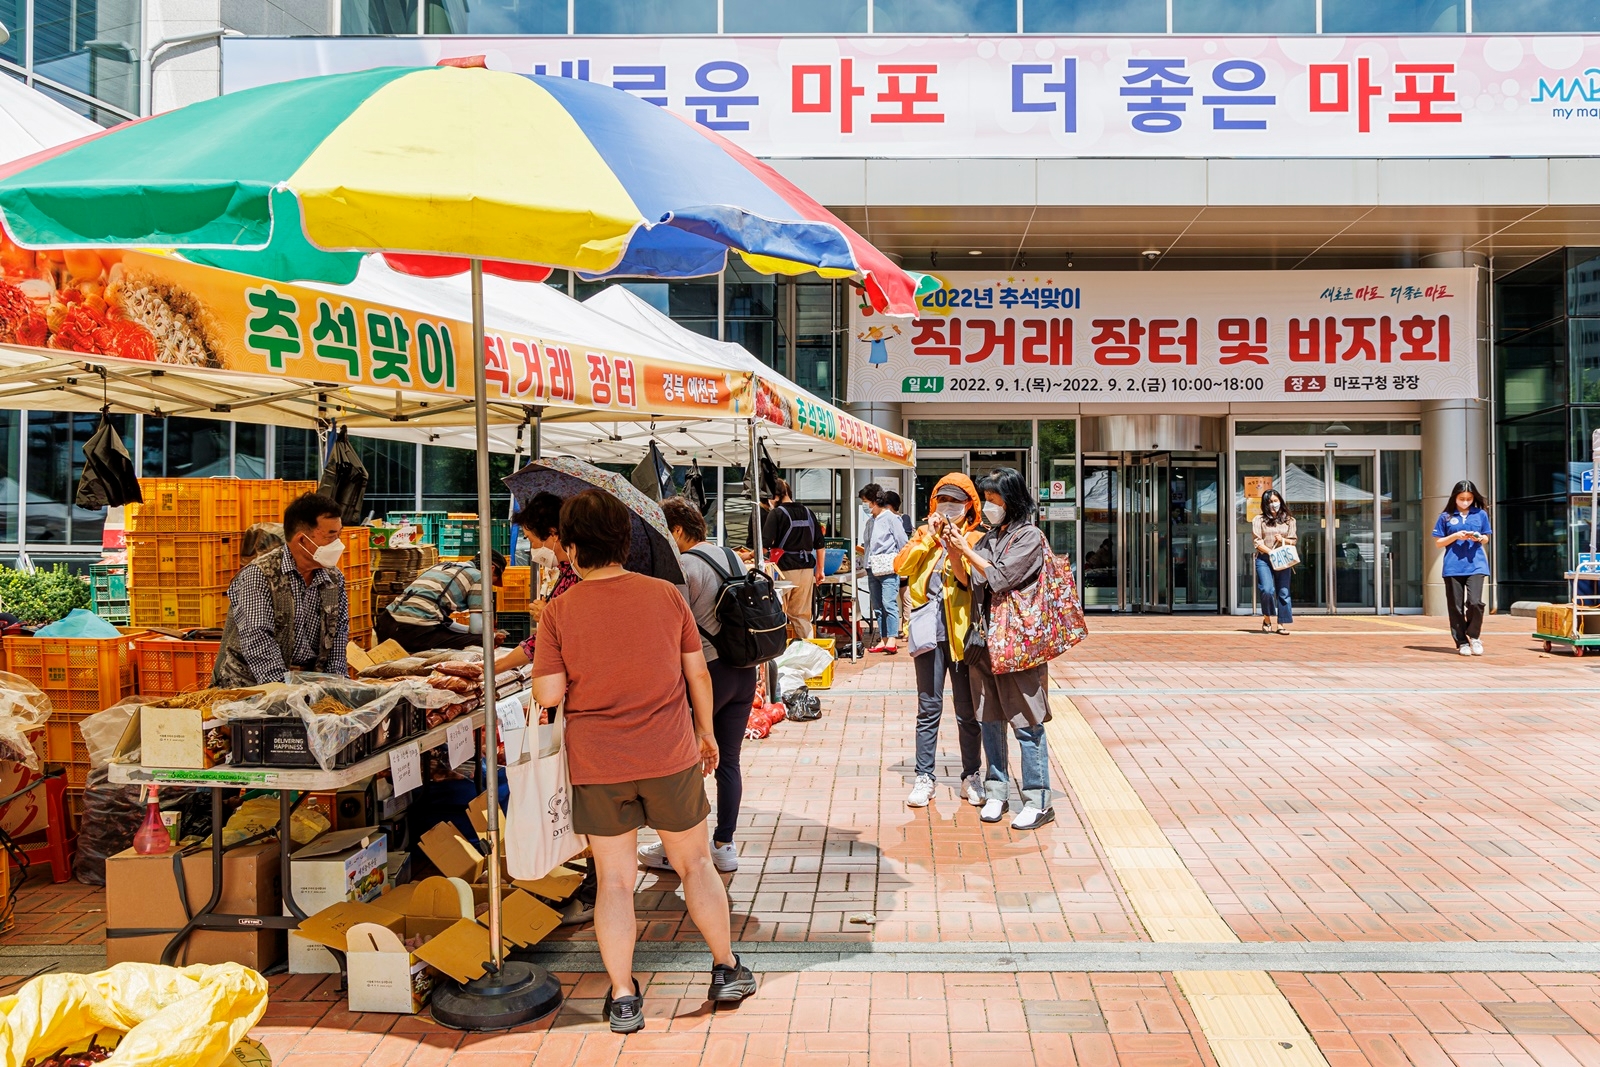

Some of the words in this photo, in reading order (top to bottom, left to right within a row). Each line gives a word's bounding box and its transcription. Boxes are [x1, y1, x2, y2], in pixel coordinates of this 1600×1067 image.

[534, 59, 759, 131] 로운
[791, 58, 945, 134] 마포
[1011, 57, 1077, 133] 더
[1119, 58, 1276, 133] 좋은
[1308, 57, 1462, 133] 마포
[1553, 108, 1573, 120] my
[1577, 108, 1600, 119] ma
[921, 287, 993, 309] 2022년
[999, 287, 1081, 309] 추석맞이
[1320, 286, 1354, 303] 새로운
[1355, 285, 1385, 301] 마포
[1390, 285, 1402, 304] 더
[1425, 284, 1454, 302] 마포
[248, 289, 455, 388] 추석맞이
[484, 336, 576, 401] 직거래
[587, 354, 637, 407] 장터
[910, 317, 1073, 365] 직거래
[1091, 317, 1198, 365] 장터
[1218, 316, 1270, 365] 및
[1288, 314, 1451, 364] 바자회
[662, 373, 685, 402] 경북
[687, 376, 719, 405] 예천군
[950, 378, 990, 391] 2022.
[995, 378, 1009, 391] 9.
[1107, 378, 1121, 391] 9.
[1126, 378, 1166, 392] 2.(금)
[1171, 377, 1264, 391] 10:00~18:00
[1333, 375, 1387, 390] 마포구청
[1392, 375, 1419, 390] 광장
[796, 397, 836, 441] 추석맞이
[838, 415, 864, 450] 직거래
[864, 425, 880, 454] 장터
[1270, 547, 1294, 568] PAIRS
